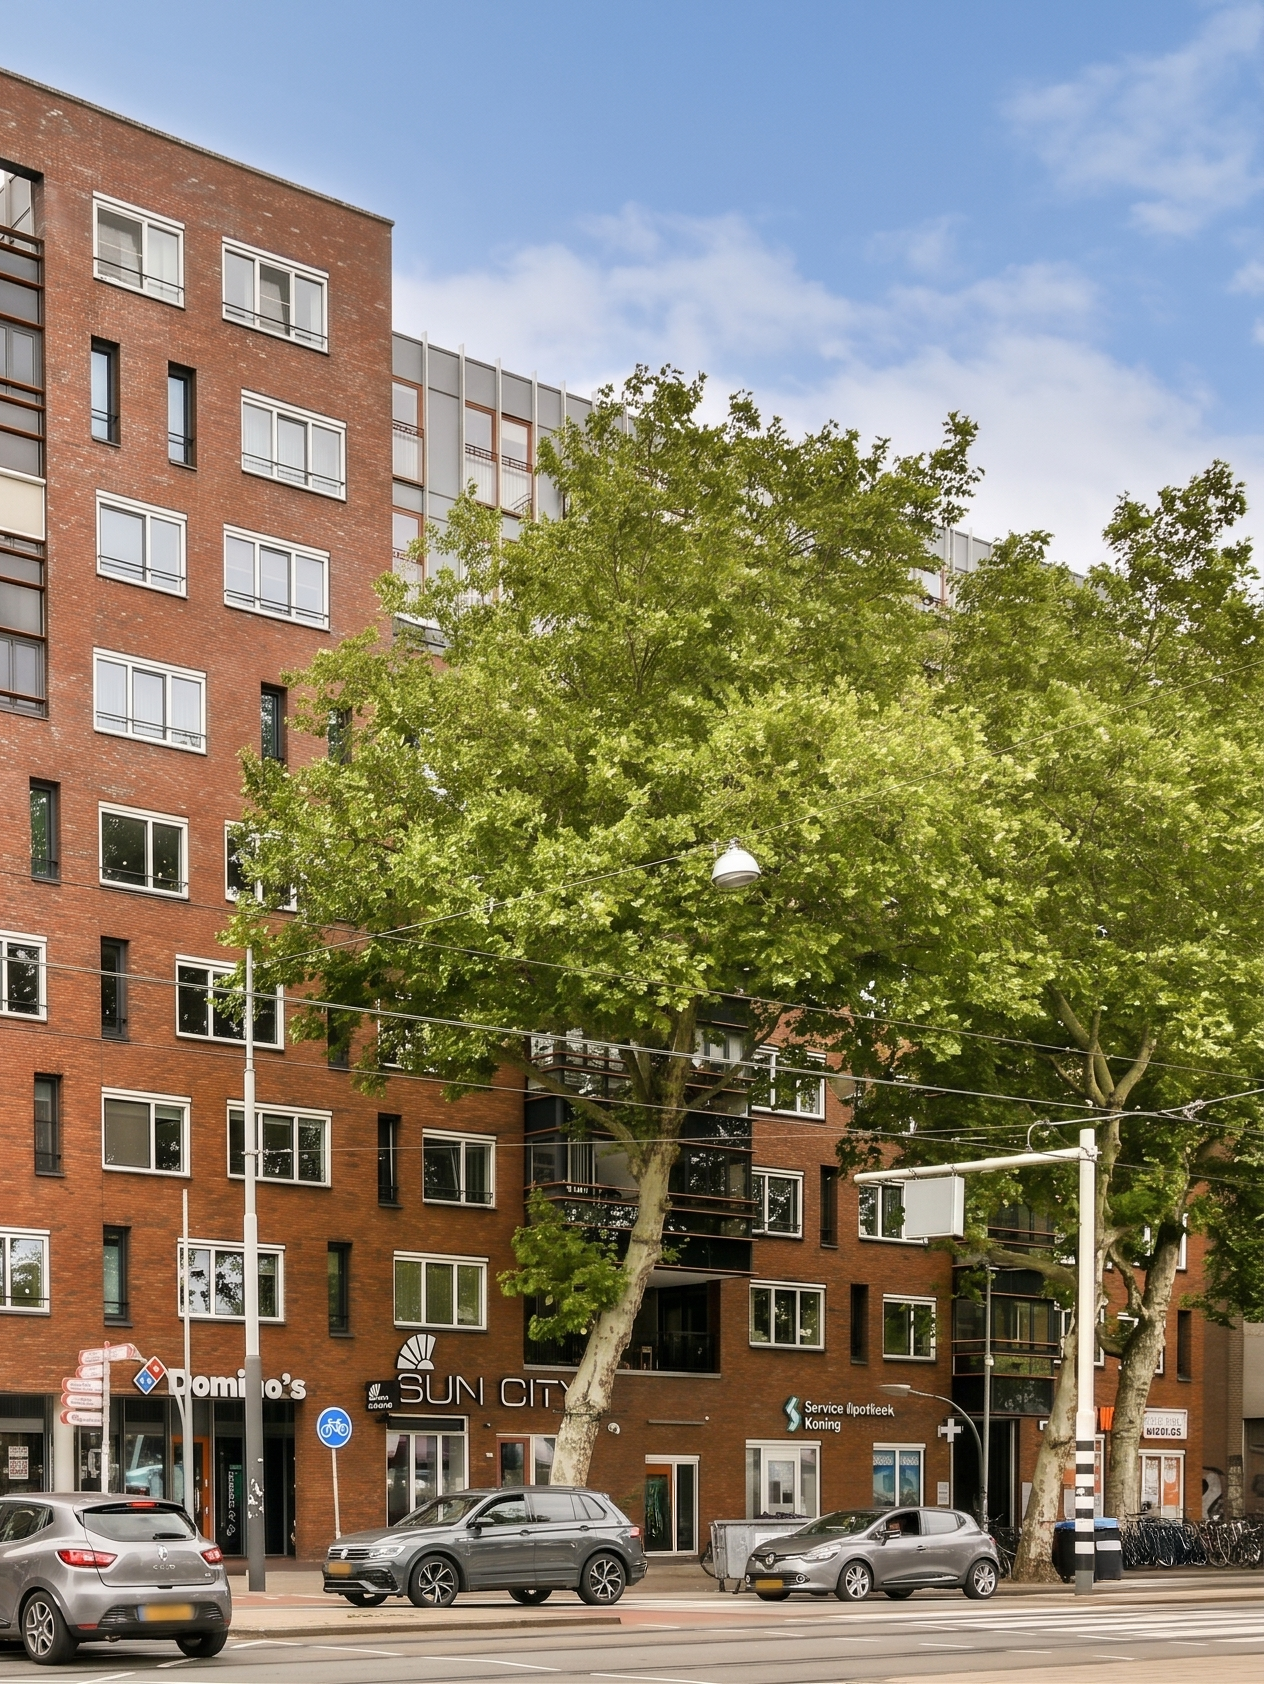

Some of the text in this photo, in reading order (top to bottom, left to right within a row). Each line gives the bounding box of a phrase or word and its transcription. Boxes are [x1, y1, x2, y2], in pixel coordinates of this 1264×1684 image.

[168, 1368, 307, 1400] Domio's
[398, 1373, 483, 1406] SUN
[804, 1400, 844, 1414] Service
[804, 1417, 841, 1433] Koning
